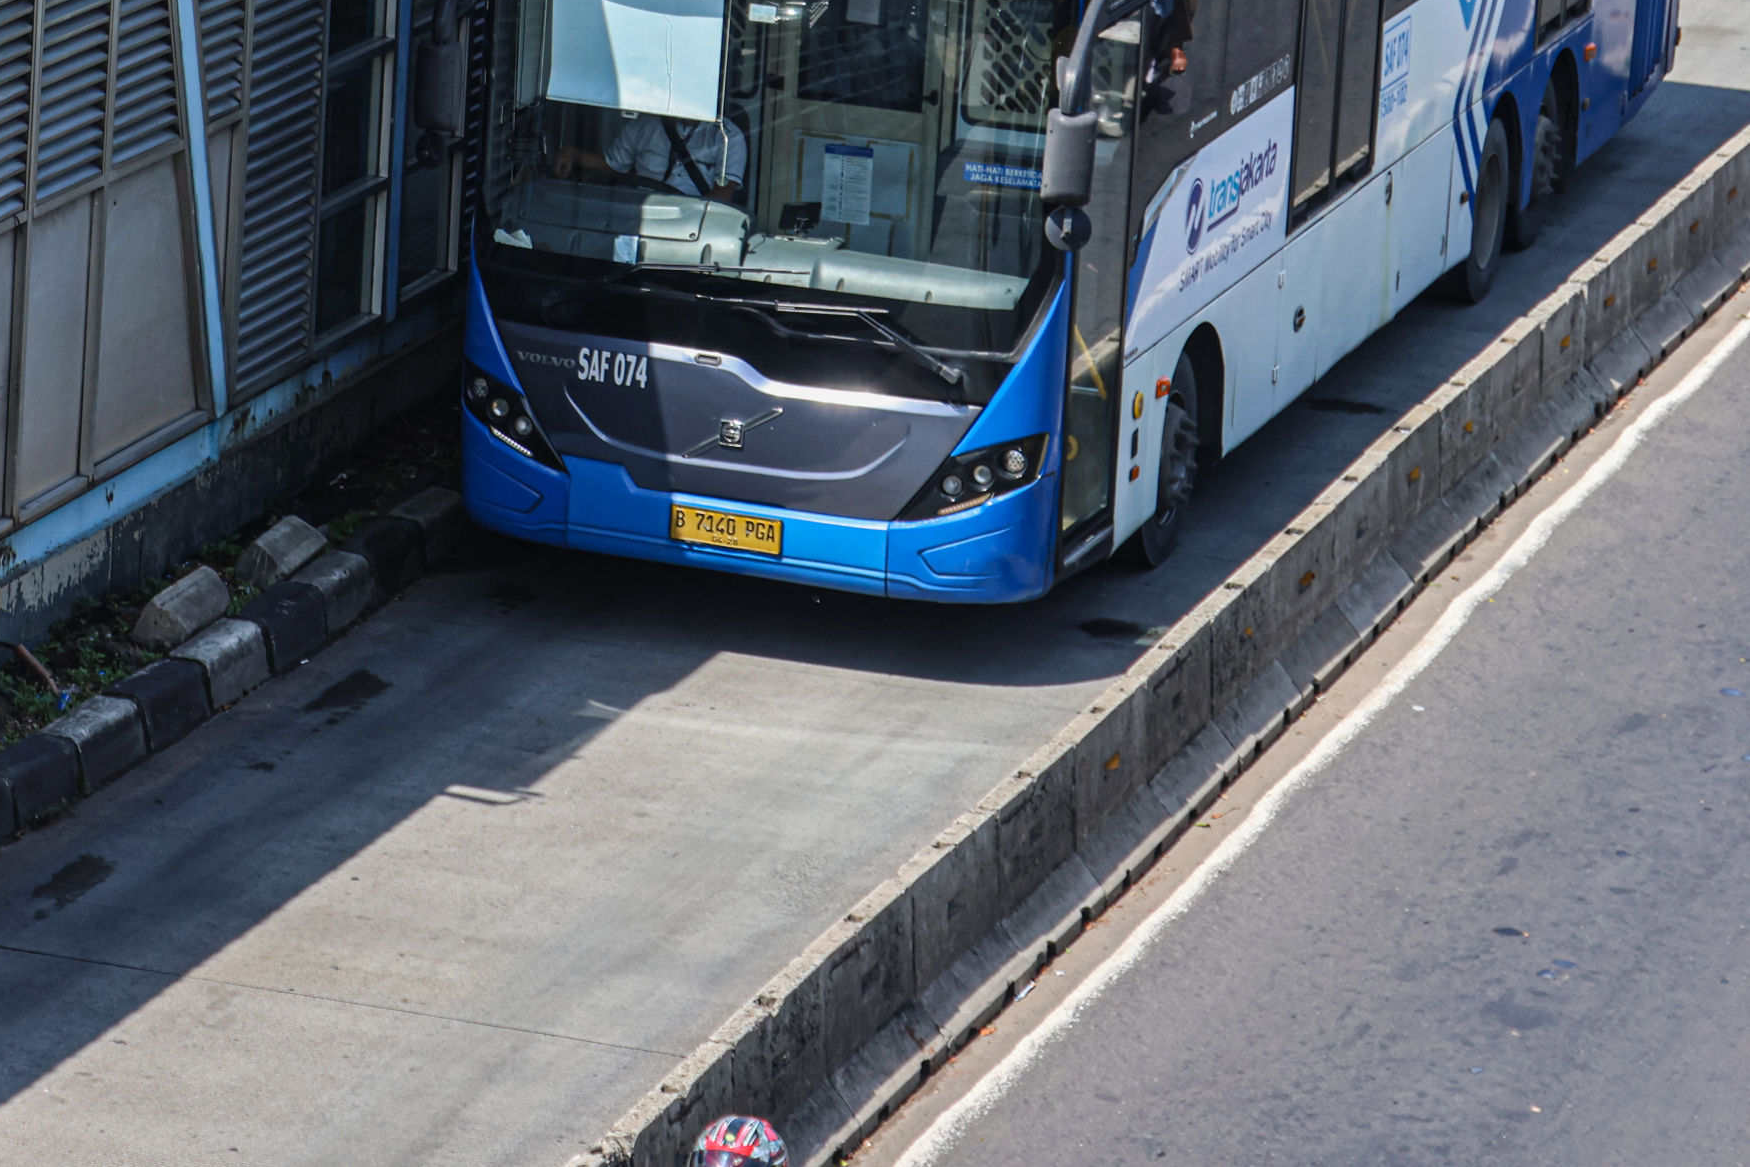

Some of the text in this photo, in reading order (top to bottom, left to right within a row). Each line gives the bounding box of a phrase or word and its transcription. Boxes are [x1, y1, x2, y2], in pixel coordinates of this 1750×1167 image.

[965, 164, 1003, 175] HATI-HATI
[970, 174, 993, 183] JAGA
[1208, 139, 1278, 220] transjakarta
[1180, 257, 1204, 292] SMART
[1204, 243, 1229, 274] Mobility
[1260, 210, 1273, 232] City
[516, 350, 576, 369] VOLVO
[578, 347, 648, 388] SAF 074
[676, 510, 775, 542] B 7140 PGA
